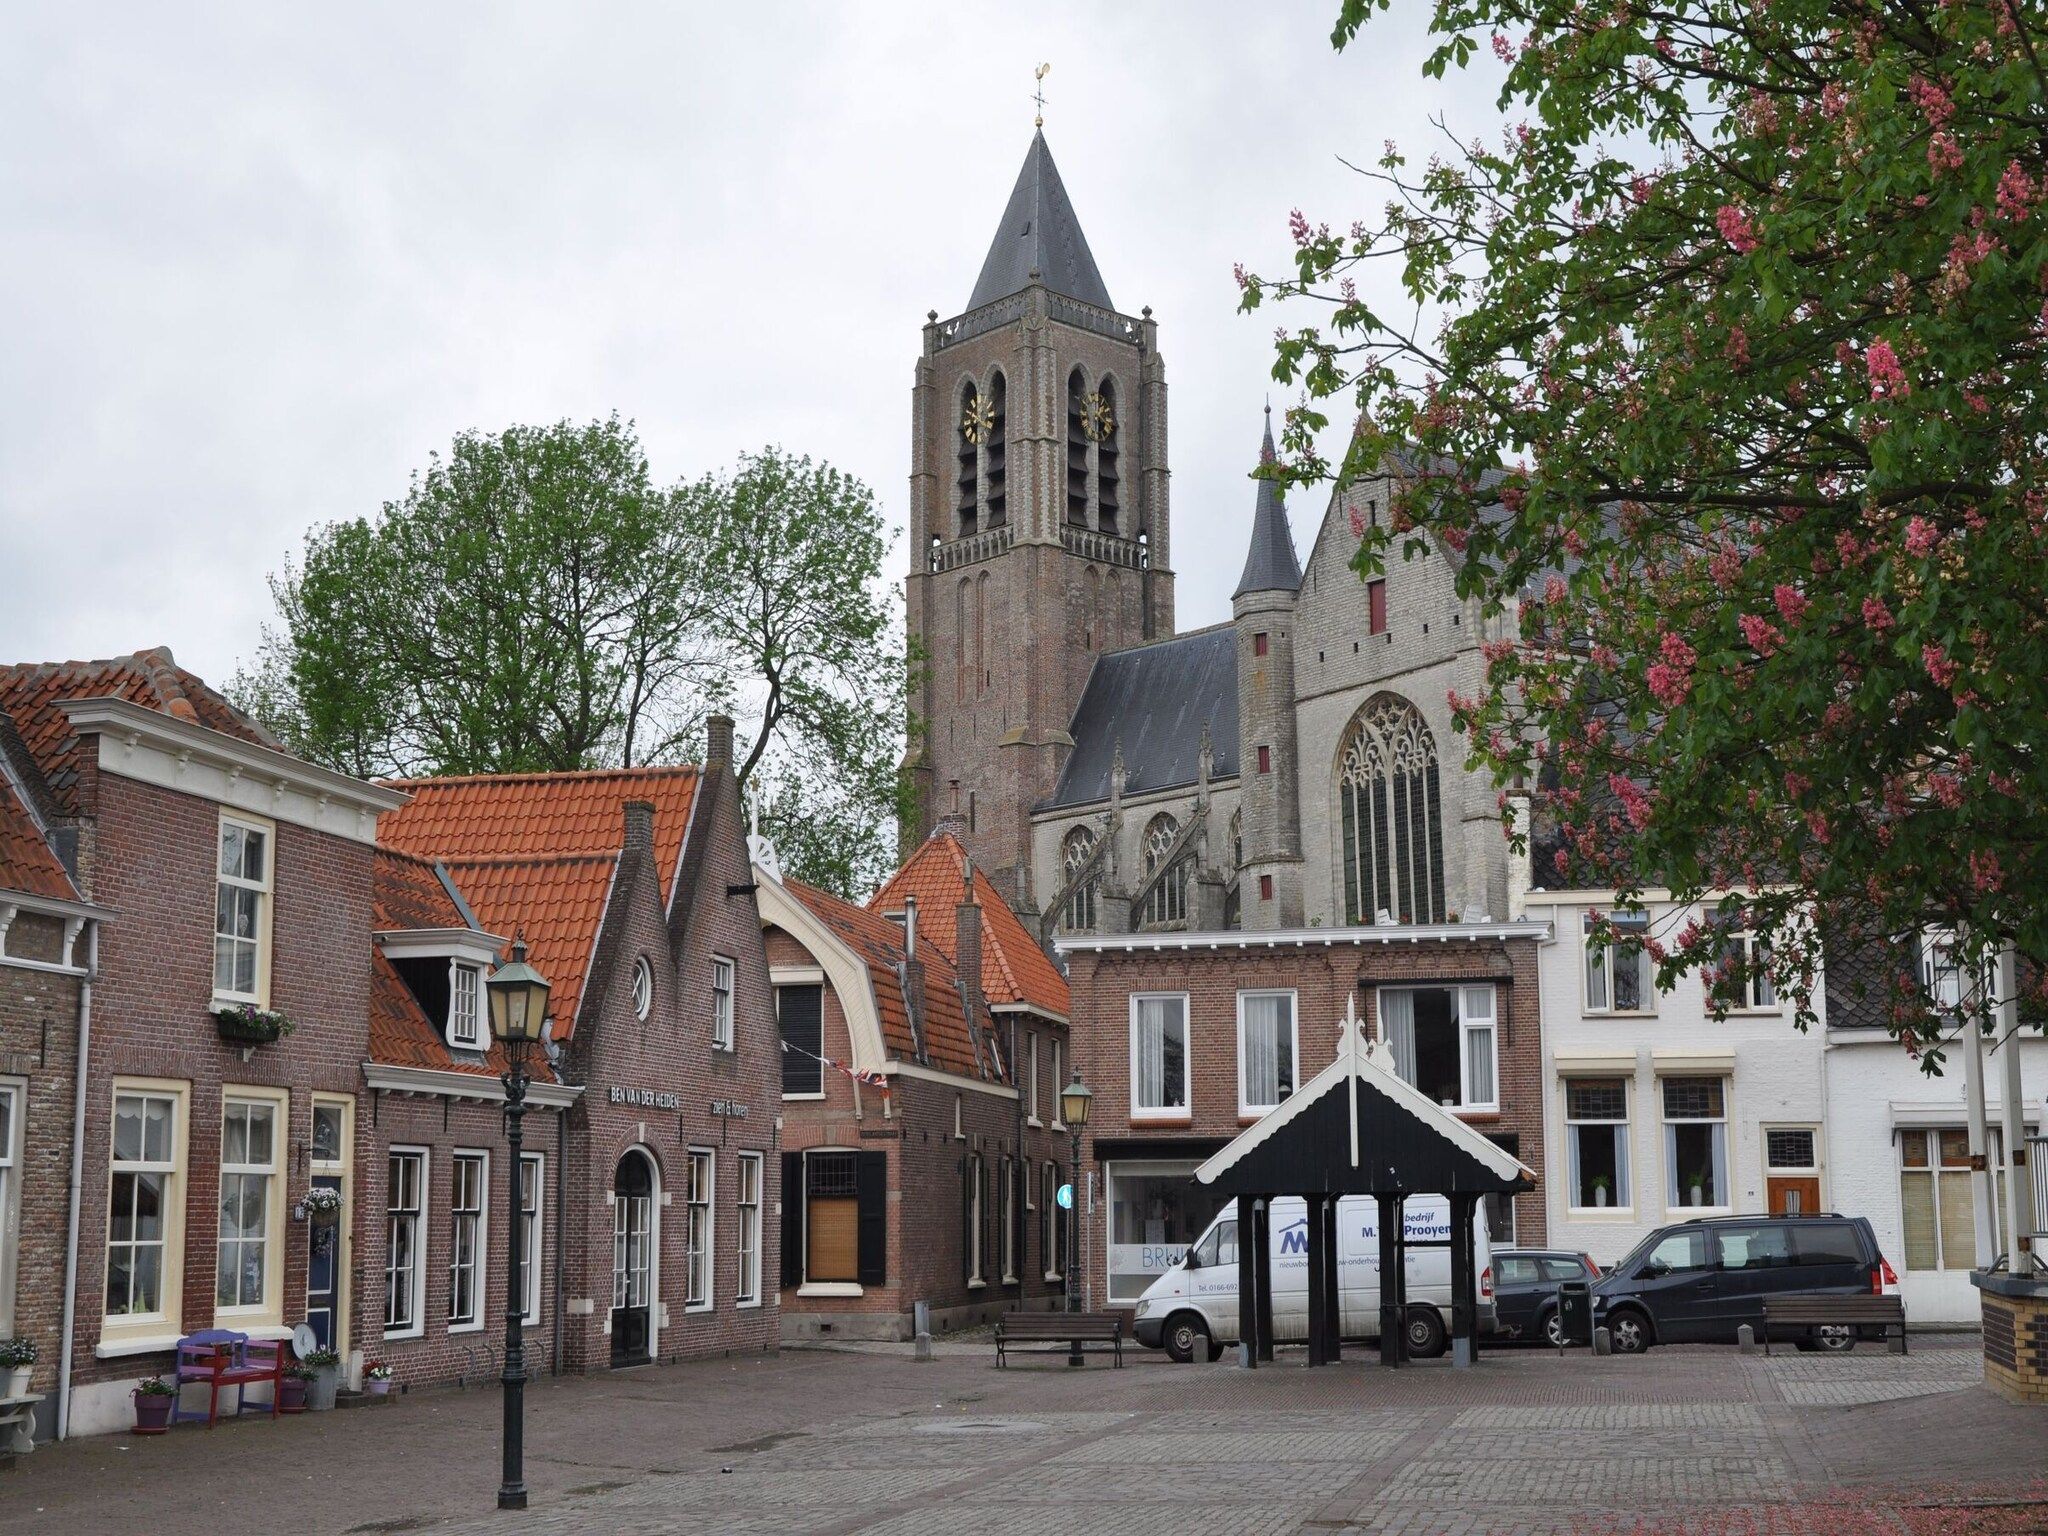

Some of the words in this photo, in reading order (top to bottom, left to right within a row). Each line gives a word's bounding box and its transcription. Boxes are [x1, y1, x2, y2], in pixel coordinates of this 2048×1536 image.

[611, 1087, 626, 1103] BEN
[626, 1088, 640, 1104] VAN
[641, 1090, 655, 1106] DER
